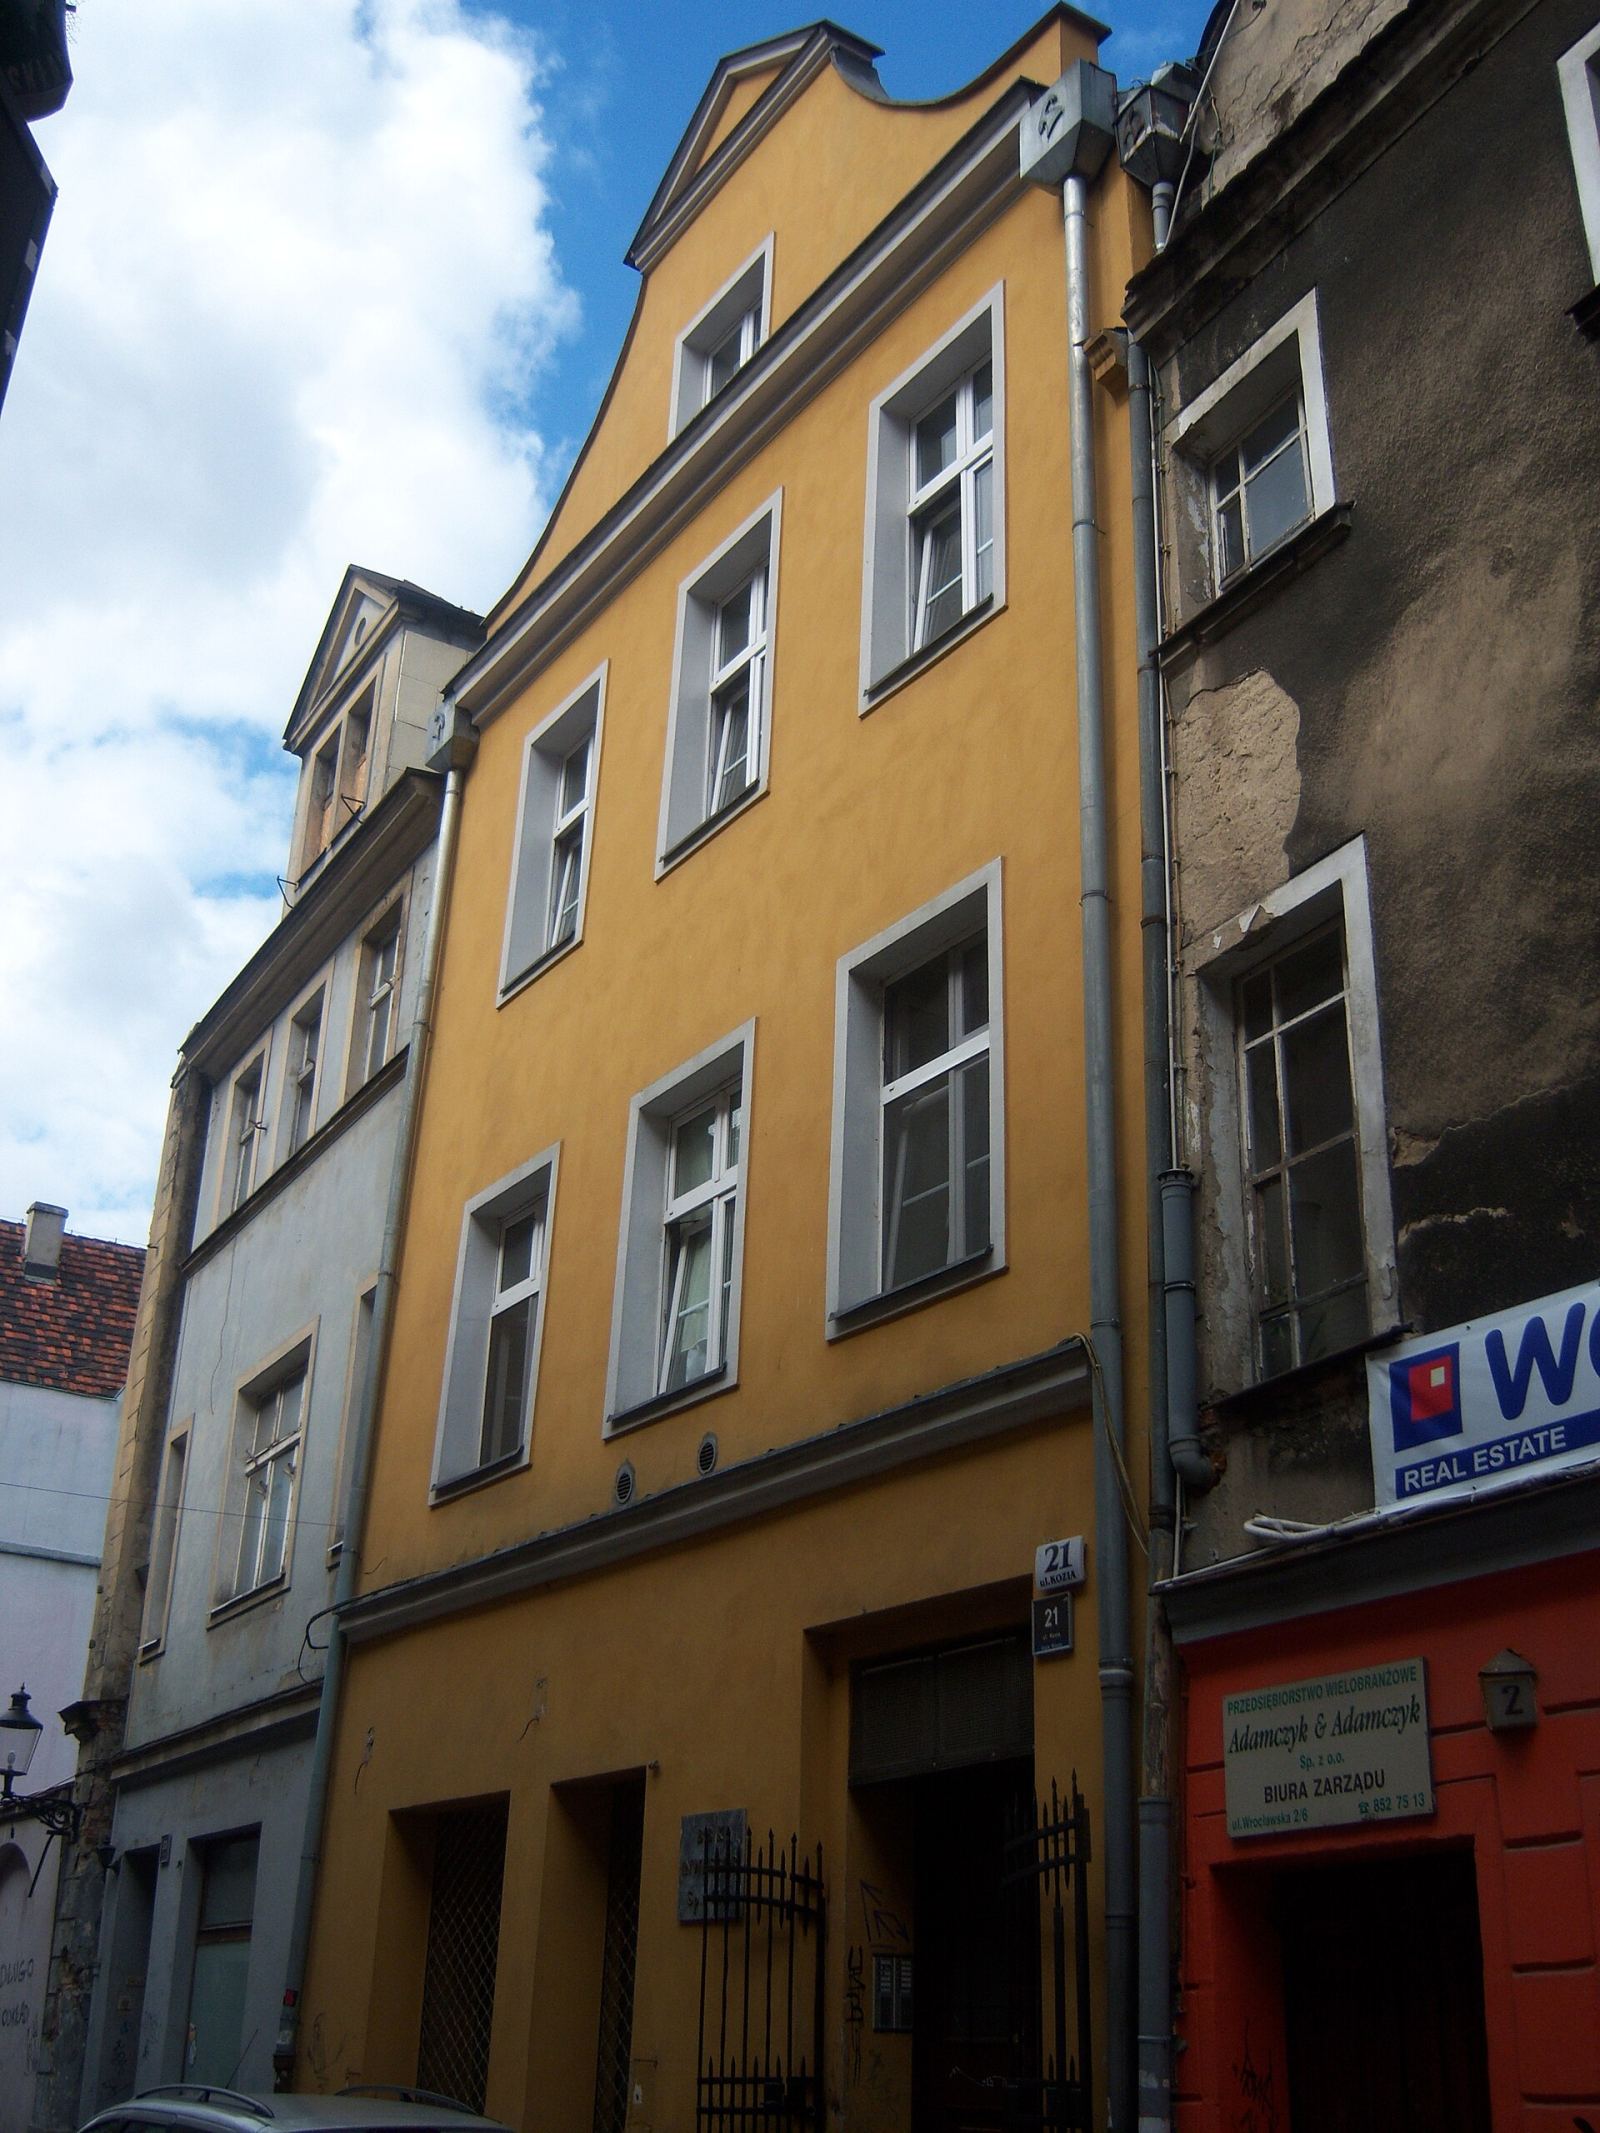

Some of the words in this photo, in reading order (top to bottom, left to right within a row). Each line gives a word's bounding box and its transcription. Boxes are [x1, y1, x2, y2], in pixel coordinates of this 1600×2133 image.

[1484, 1302, 1600, 1421] W
[1404, 1457, 1467, 1492] REAL
[1473, 1425, 1567, 1473] ESTATE
[1044, 1540, 1073, 1573] 21
[1044, 1605, 1059, 1628] 21
[1227, 1685, 1323, 1715] PRZEDSIĘBIORSTWO
[1325, 1665, 1417, 1696] WIELOBRANŻOWE
[1502, 1684, 1523, 1715] 2
[1229, 1714, 1308, 1753] Adamczyk
[1315, 1712, 1327, 1739] &
[1331, 1694, 1420, 1736] Adamczyk
[1300, 1754, 1315, 1772] Sp.
[1318, 1755, 1324, 1766] z
[1327, 1752, 1344, 1765] o.o.
[1264, 1781, 1308, 1803] BIURA
[1313, 1768, 1385, 1797] ZARZĄDU
[1373, 1796, 1392, 1812] 852
[1396, 1794, 1409, 1809] 75
[1413, 1792, 1425, 1808] 13
